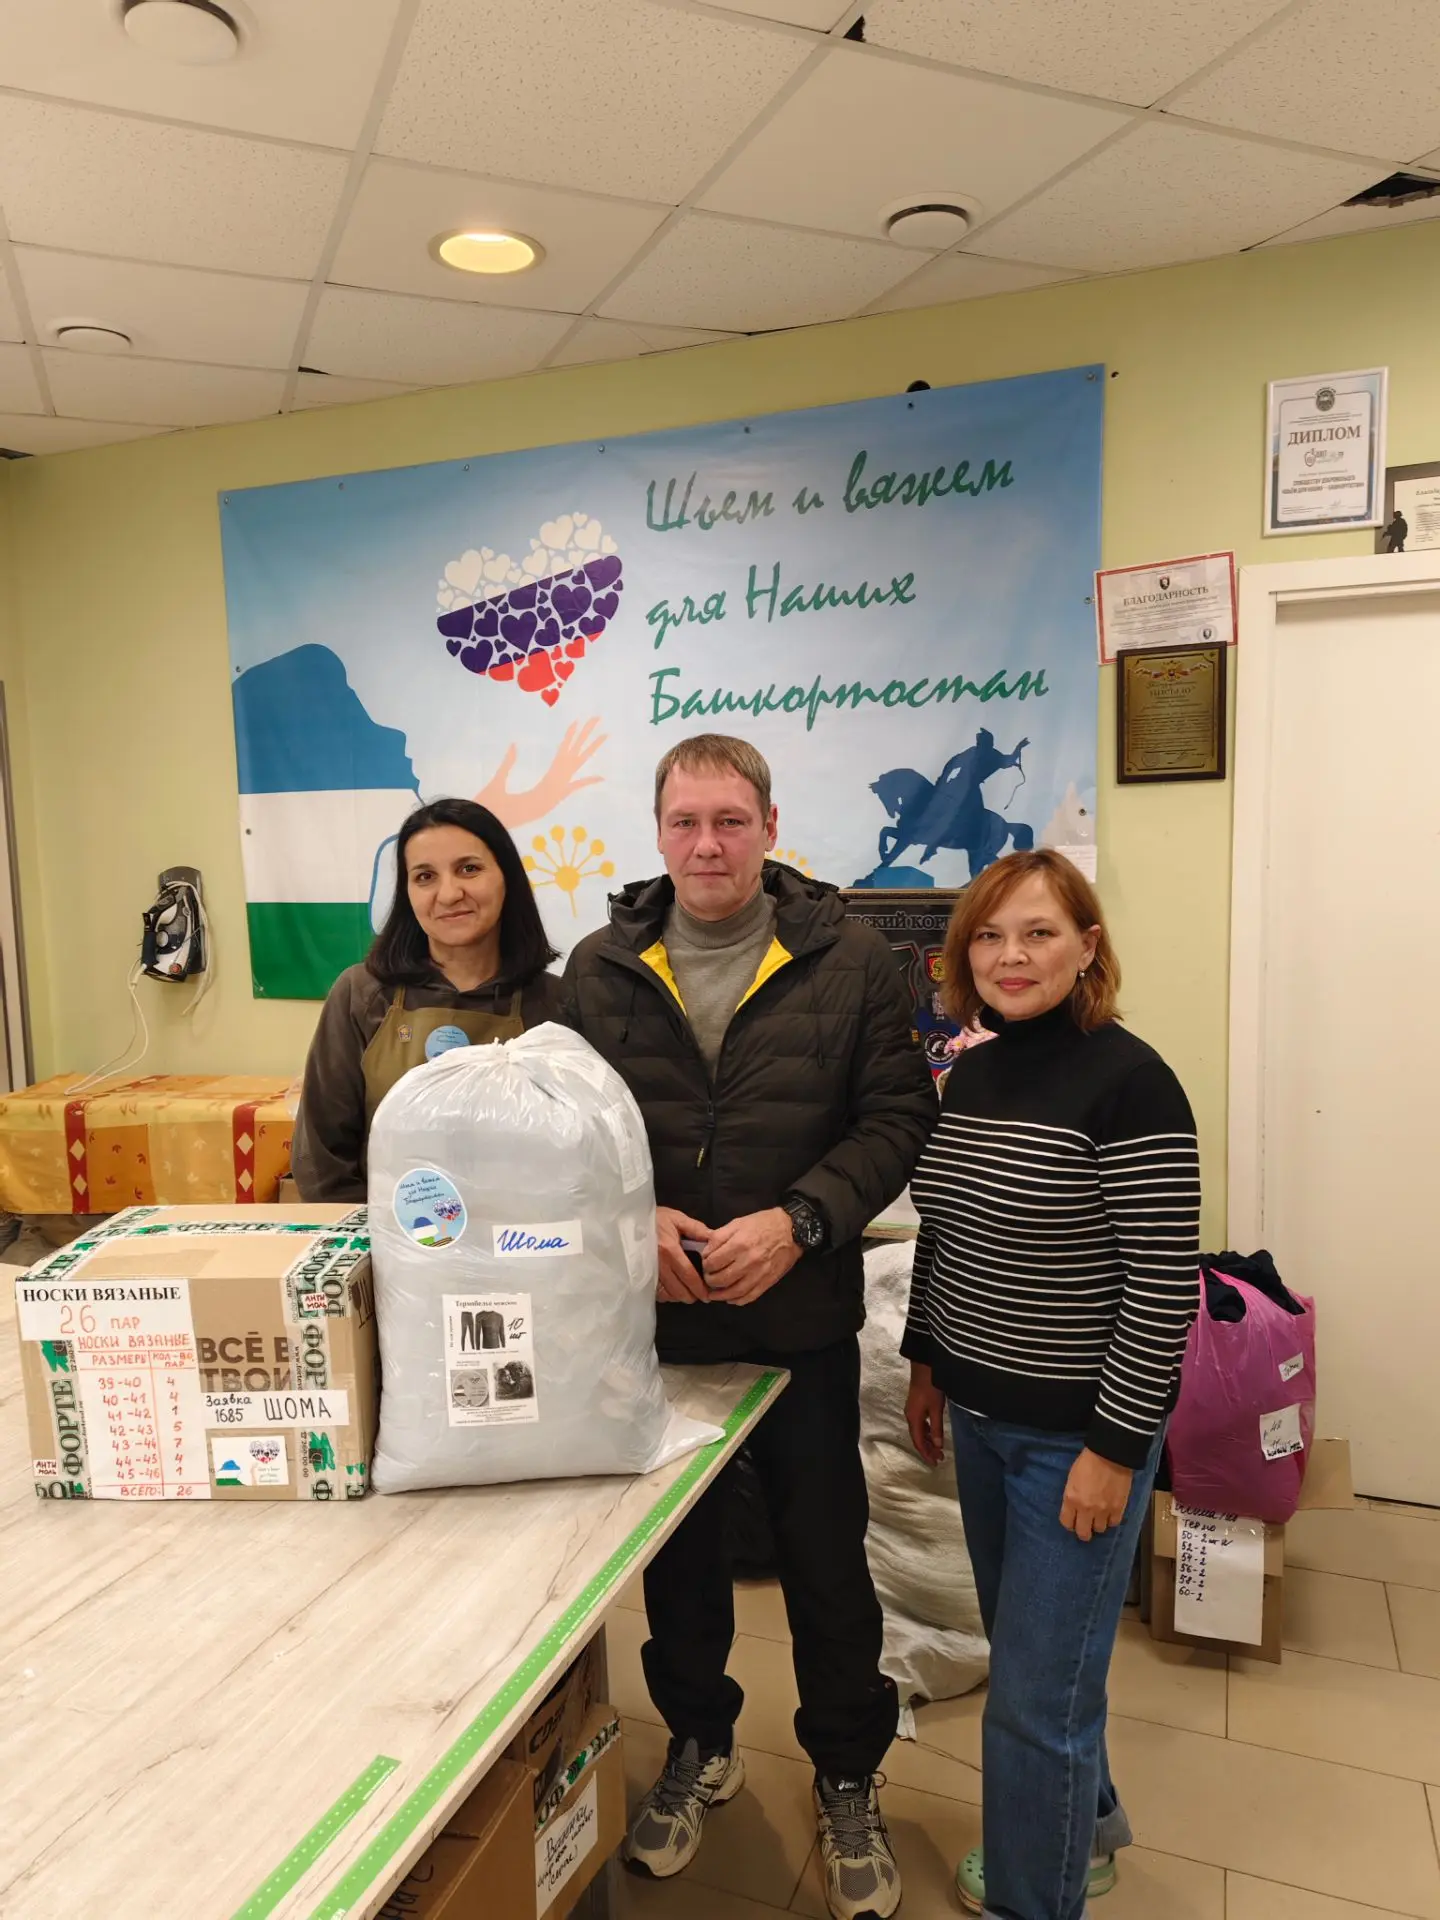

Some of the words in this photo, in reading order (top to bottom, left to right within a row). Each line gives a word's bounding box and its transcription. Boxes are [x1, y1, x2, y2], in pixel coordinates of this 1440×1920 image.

[1287, 425, 1361, 446] ДИПЛОМ
[647, 471, 775, 531] Шьем
[792, 486, 825, 514] и
[842, 450, 1014, 513] вяжем
[1123, 586, 1209, 607] БЛАГОДАРНОСТЬ
[646, 590, 726, 649] для
[745, 561, 917, 622] Наших
[648, 667, 1049, 732] Башкортостан
[849, 910, 907, 929] СКИЙ
[497, 1229, 570, 1252] Шома
[23, 1288, 90, 1302] НОСКИ
[92, 1287, 181, 1300] ВЯЗАНЫЕ
[60, 1304, 96, 1334] 26
[110, 1316, 141, 1330] ПАР
[508, 1318, 524, 1330] 10
[78, 1335, 119, 1349] НОСКИ
[128, 1334, 190, 1348] ВЯЗАНЫЕ
[167, 1376, 174, 1386] 4
[170, 1392, 178, 1402] 4
[172, 1405, 178, 1416] 1
[206, 1394, 252, 1407] Заявка
[264, 1397, 332, 1421] ШОМА
[215, 1408, 244, 1423] 1685
[51, 1379, 84, 1476] ФОРТЕ
[174, 1421, 183, 1432] 5
[174, 1438, 182, 1448] 7
[175, 1453, 183, 1464] 4
[176, 1466, 182, 1476] 1
[176, 1486, 193, 1497] 26
